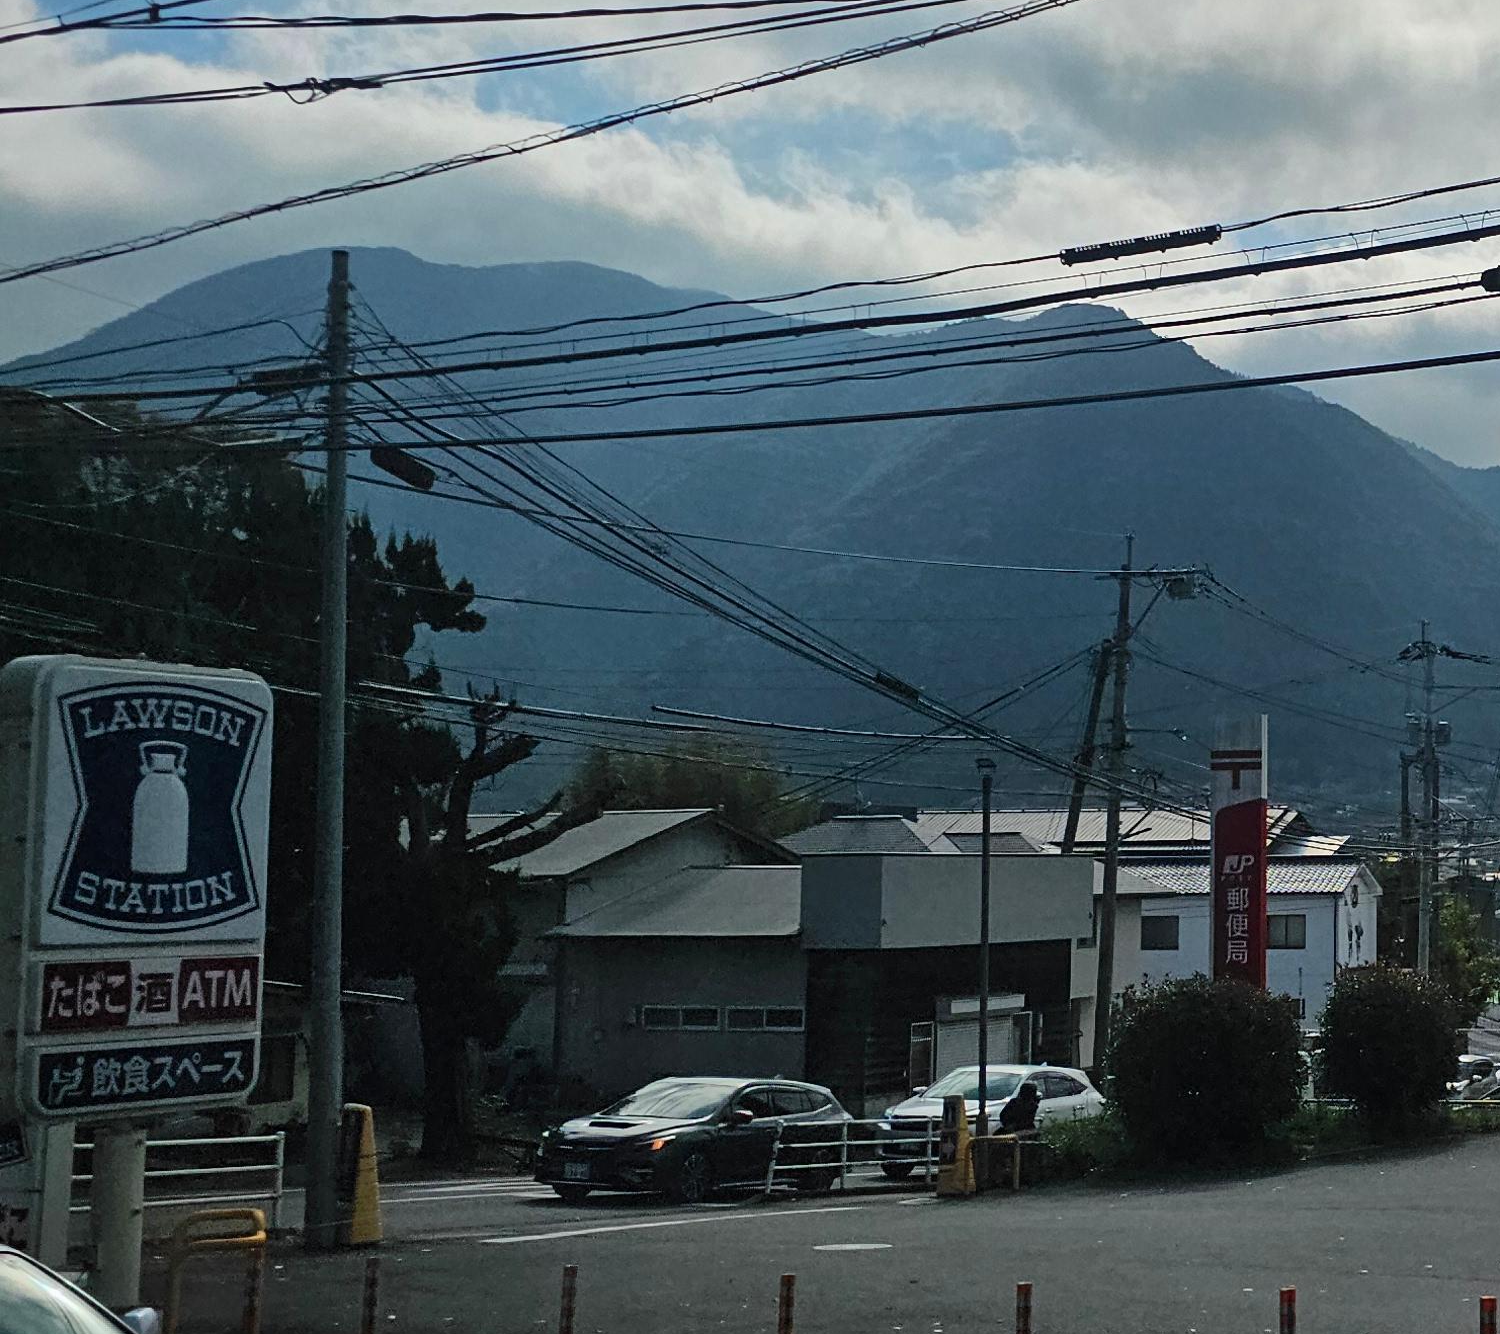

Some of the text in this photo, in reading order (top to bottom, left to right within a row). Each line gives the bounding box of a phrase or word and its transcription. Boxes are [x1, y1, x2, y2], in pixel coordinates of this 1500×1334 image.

[79, 698, 247, 748] LAWSON
[75, 870, 238, 915] STATION
[1225, 887, 1249, 964] 郵便局
[47, 970, 252, 1018] たばこ 酒 ATM
[93, 1050, 245, 1097] 飲食スペース
